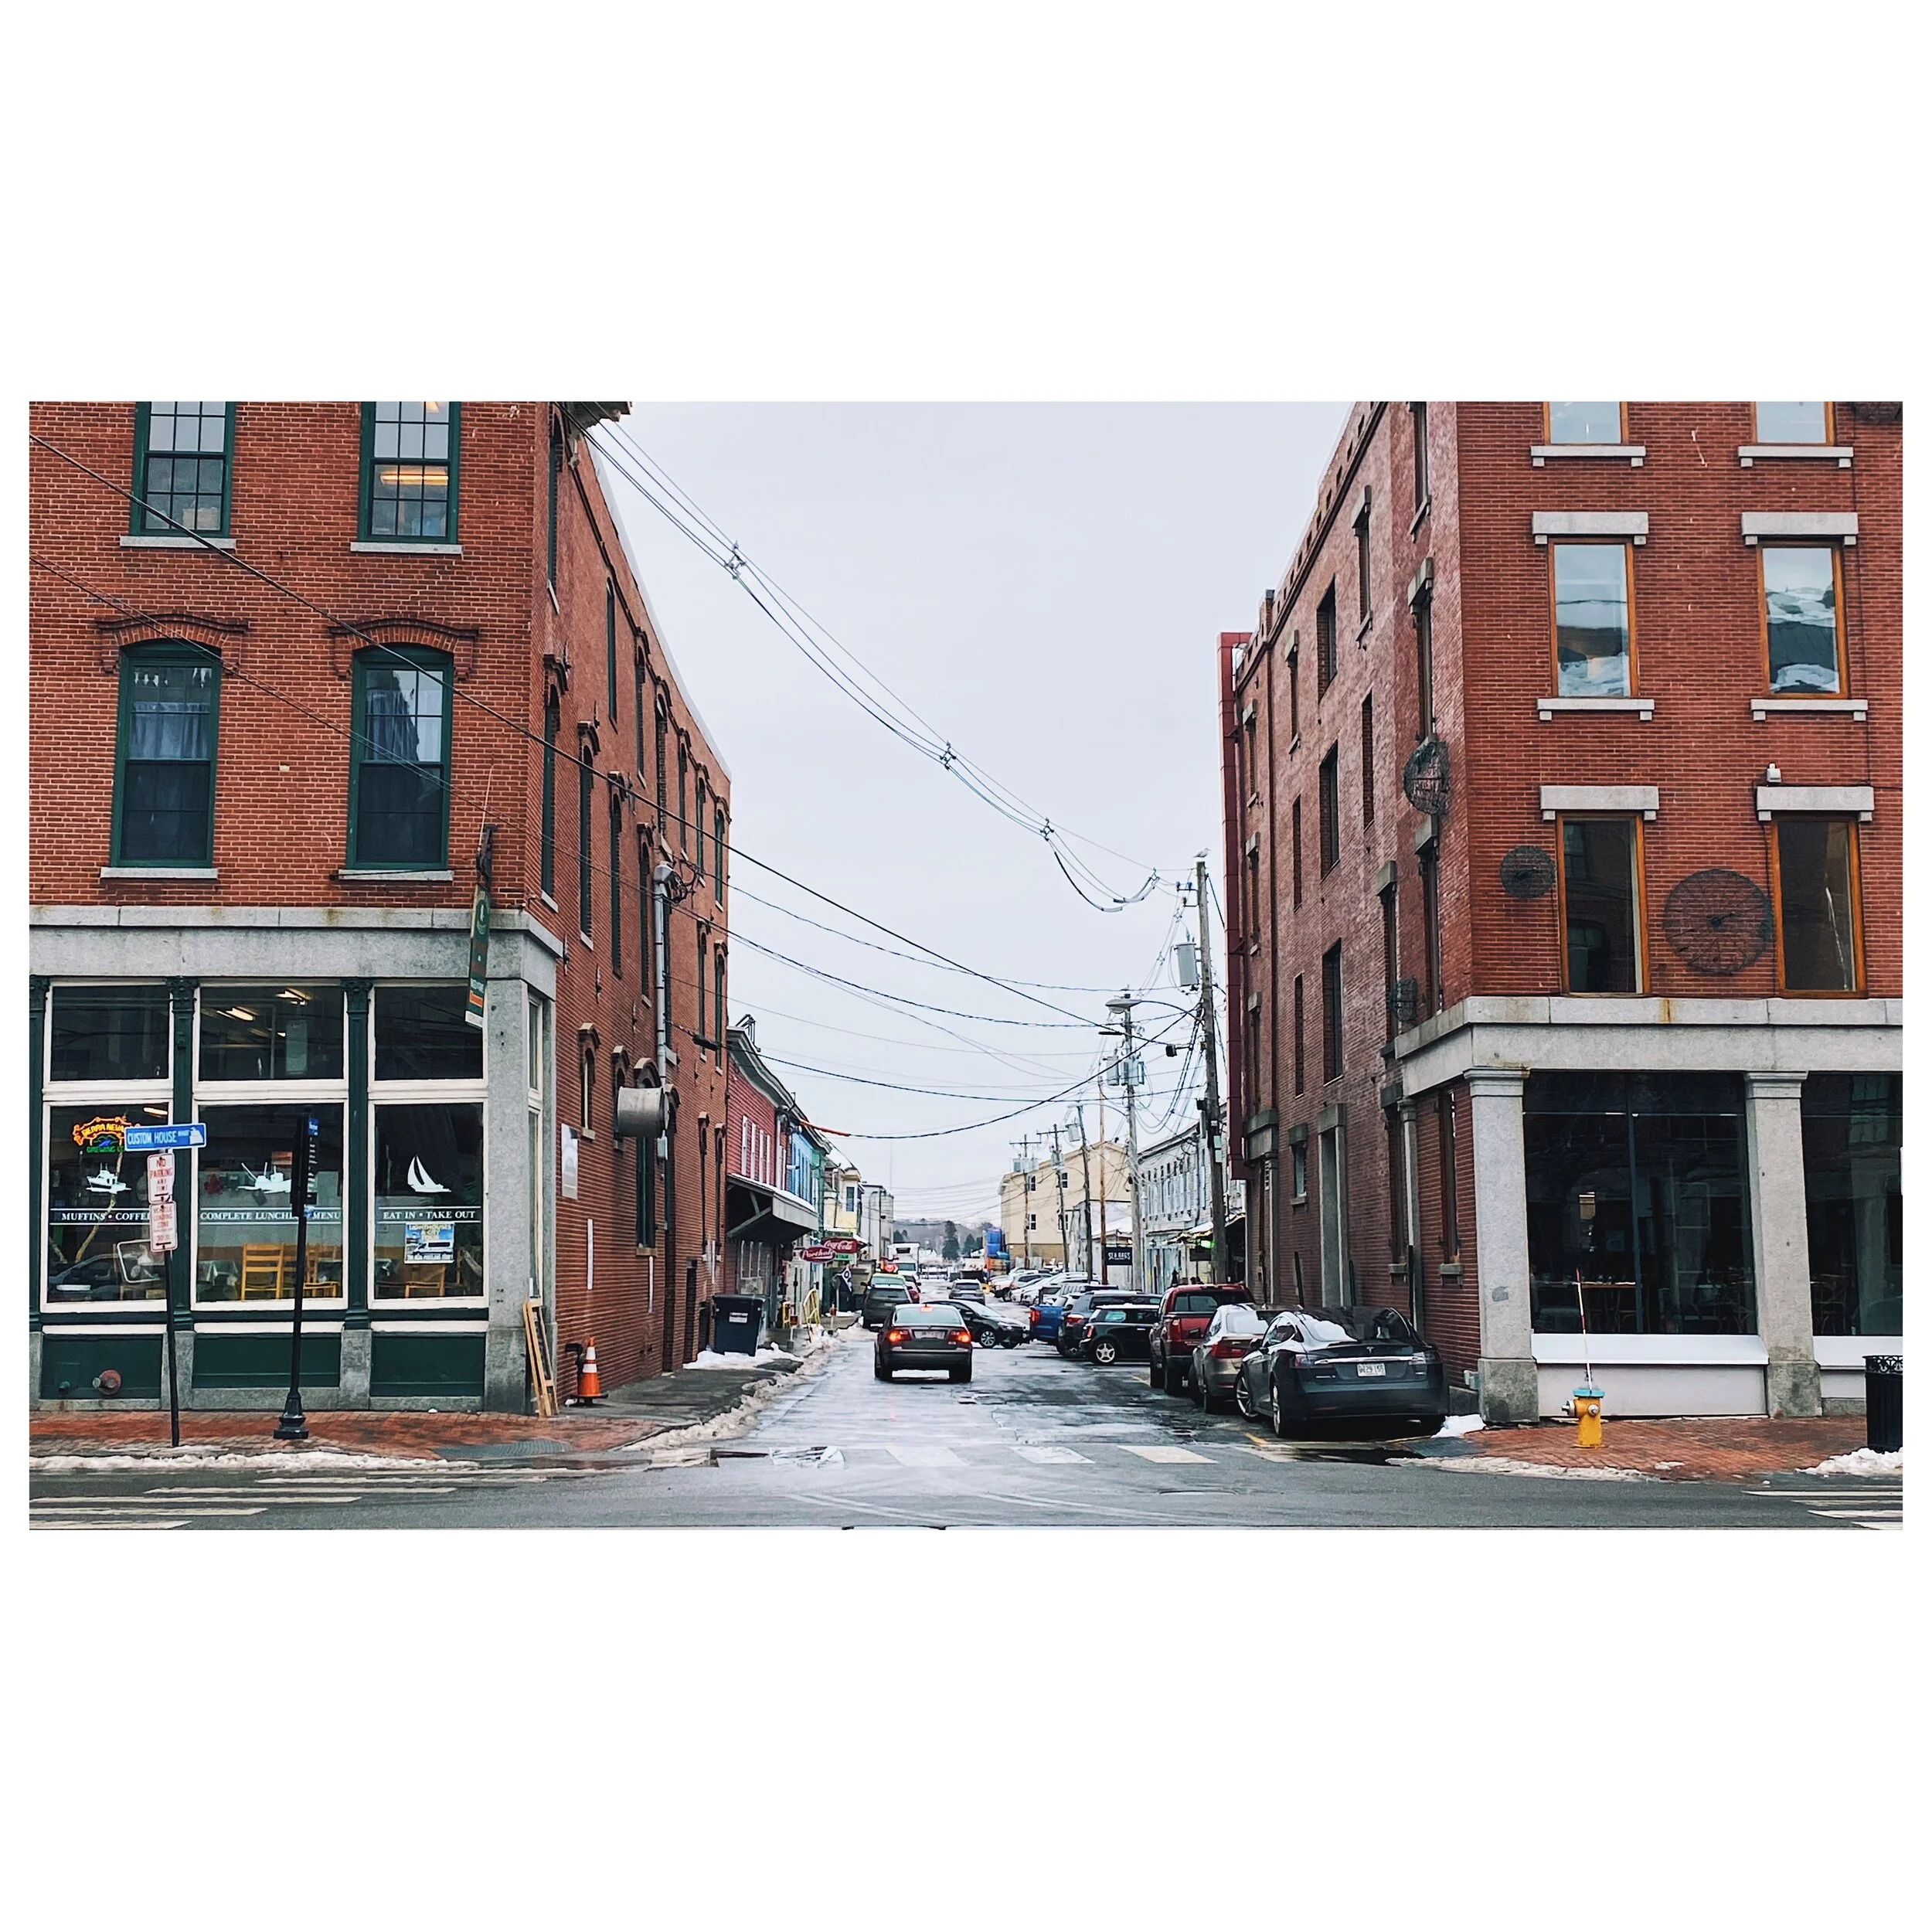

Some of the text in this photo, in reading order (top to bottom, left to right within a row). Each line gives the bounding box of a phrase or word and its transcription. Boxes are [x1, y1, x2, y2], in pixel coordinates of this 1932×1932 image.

[106, 1123, 124, 1133] NEVA
[127, 1132, 152, 1145] CUSTOM
[154, 1131, 177, 1144] HOUSE
[156, 1158, 166, 1167] NO
[149, 1168, 173, 1179] PARKING
[61, 1212, 106, 1221] MUFFINS
[200, 1211, 253, 1220] COMPLETE
[311, 1211, 341, 1219] MENU
[383, 1211, 401, 1219] EAT
[426, 1211, 453, 1219] TAKE
[454, 1210, 476, 1219] OUT
[801, 1248, 833, 1259] Porthole
